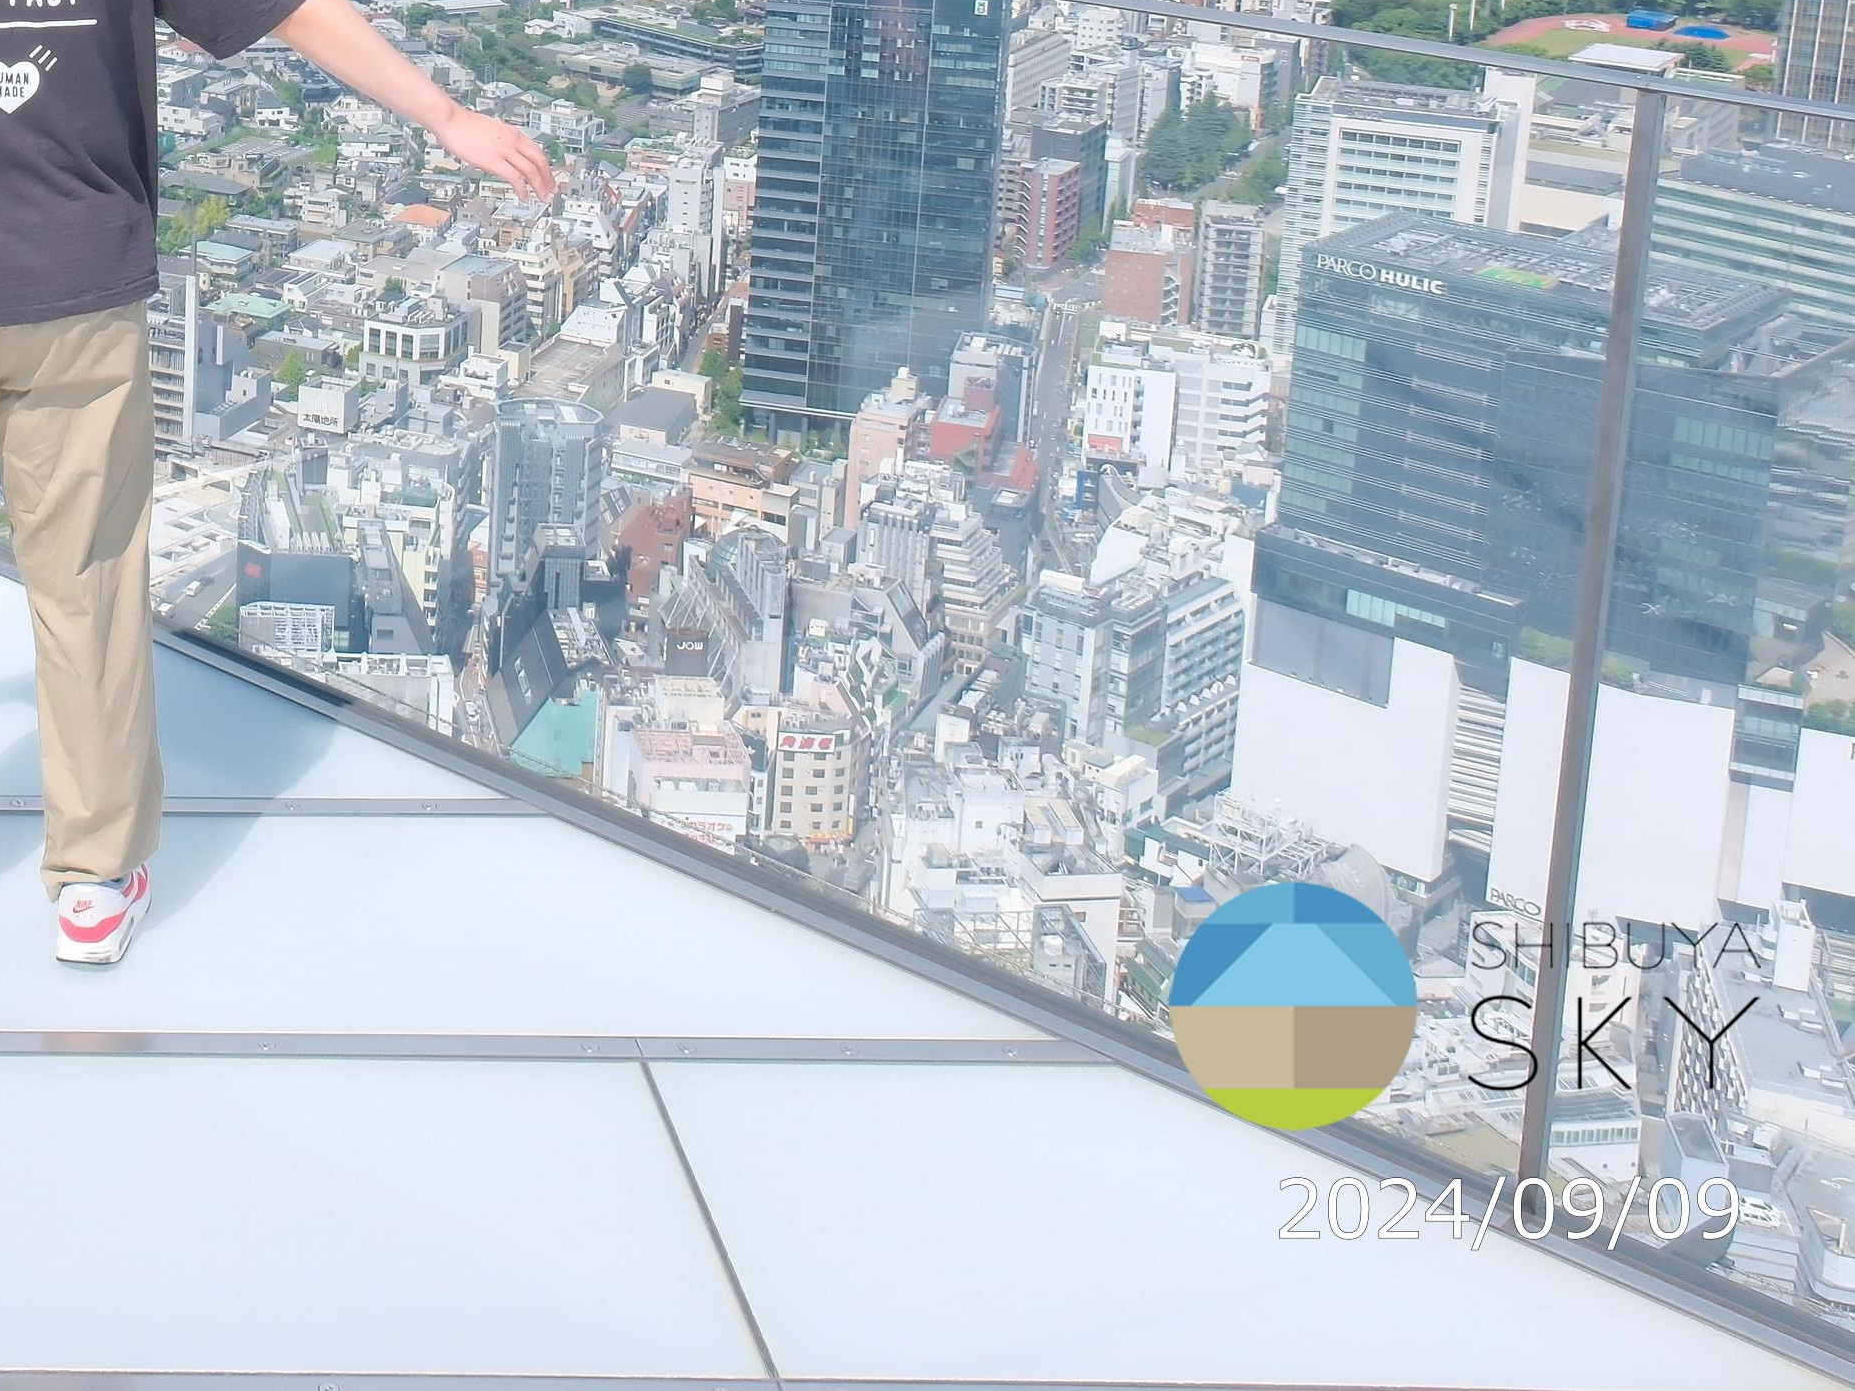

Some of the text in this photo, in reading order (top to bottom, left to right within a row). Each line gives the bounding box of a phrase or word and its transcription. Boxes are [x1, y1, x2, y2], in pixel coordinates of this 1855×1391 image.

[1316, 253, 1446, 295] PARCO HULIC
[75, 899, 94, 909] NIKE
[1490, 887, 1542, 916] PARCO
